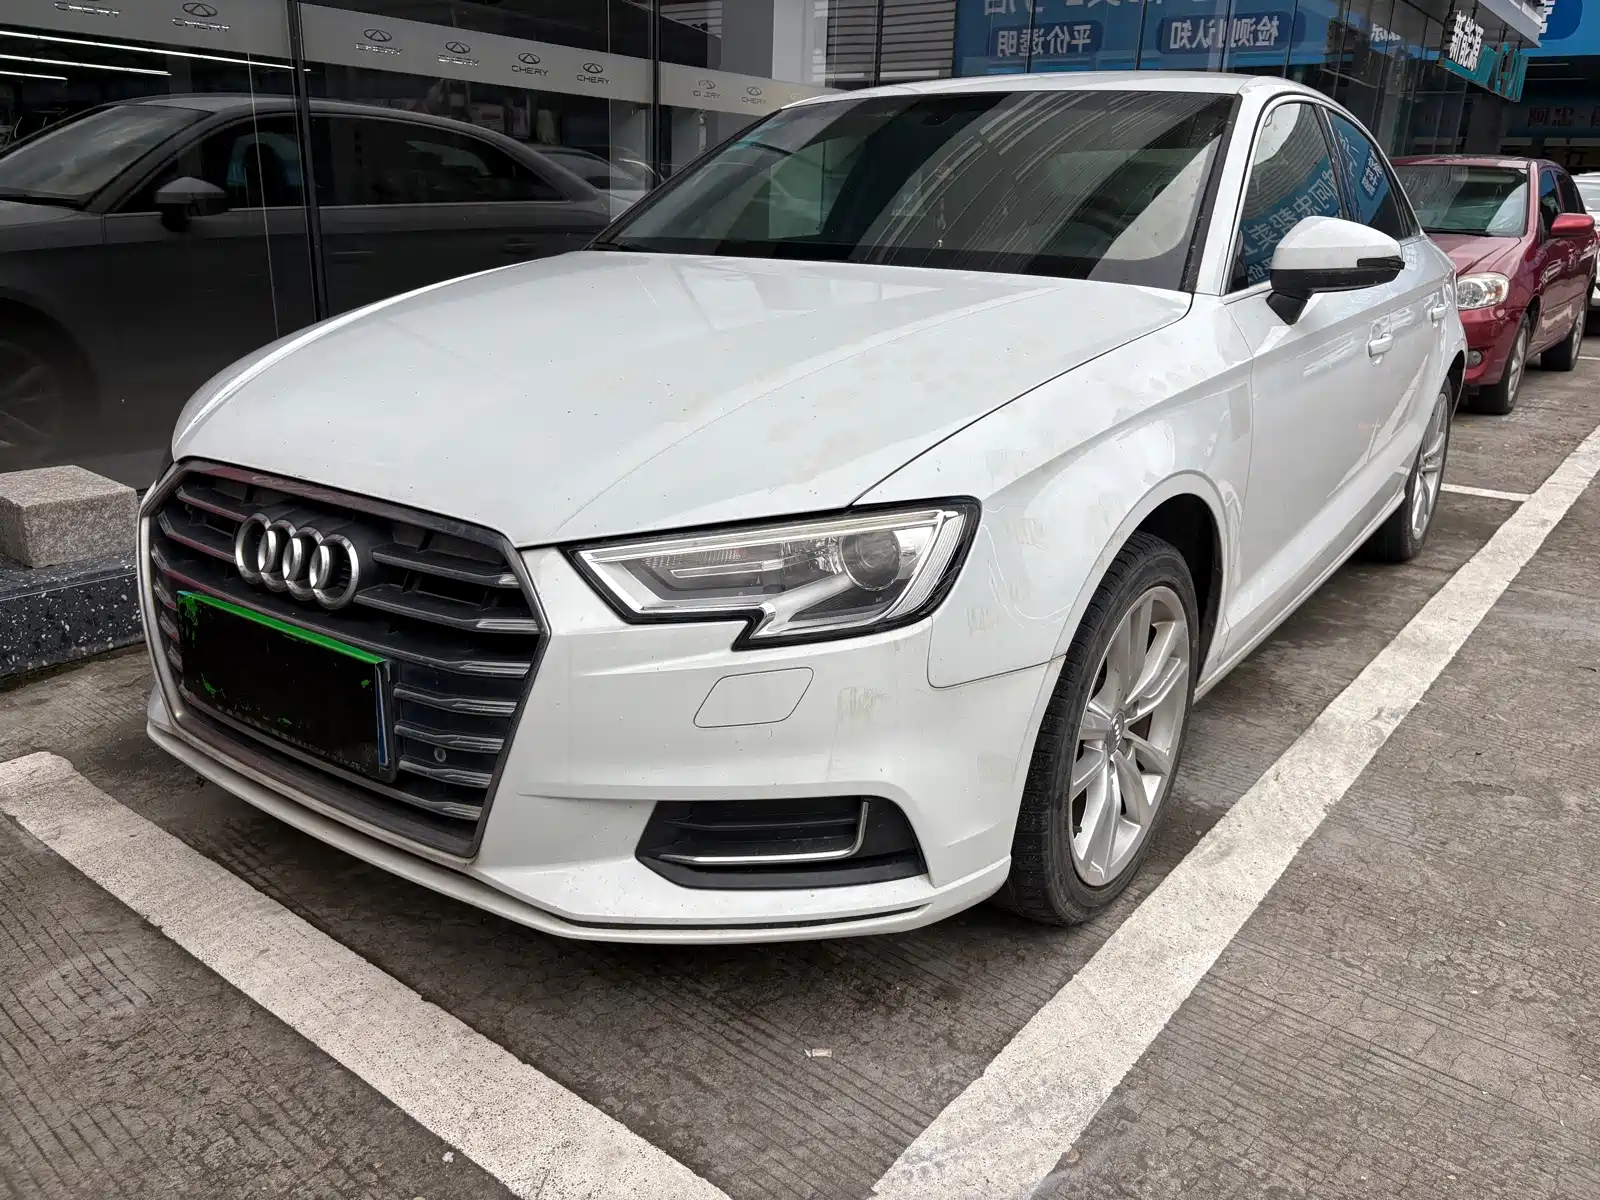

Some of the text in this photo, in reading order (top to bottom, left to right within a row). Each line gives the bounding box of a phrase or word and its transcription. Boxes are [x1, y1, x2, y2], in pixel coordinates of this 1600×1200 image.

[54, 1, 121, 18] CHERY
[172, 17, 231, 32] CHERY
[1449, 10, 1485, 72] 新能源
[355, 42, 402, 55] CHERY
[437, 54, 480, 66] CHERY
[511, 64, 549, 76] CHERY
[576, 74, 610, 85] CHERY
[741, 96, 767, 105] CHERY
